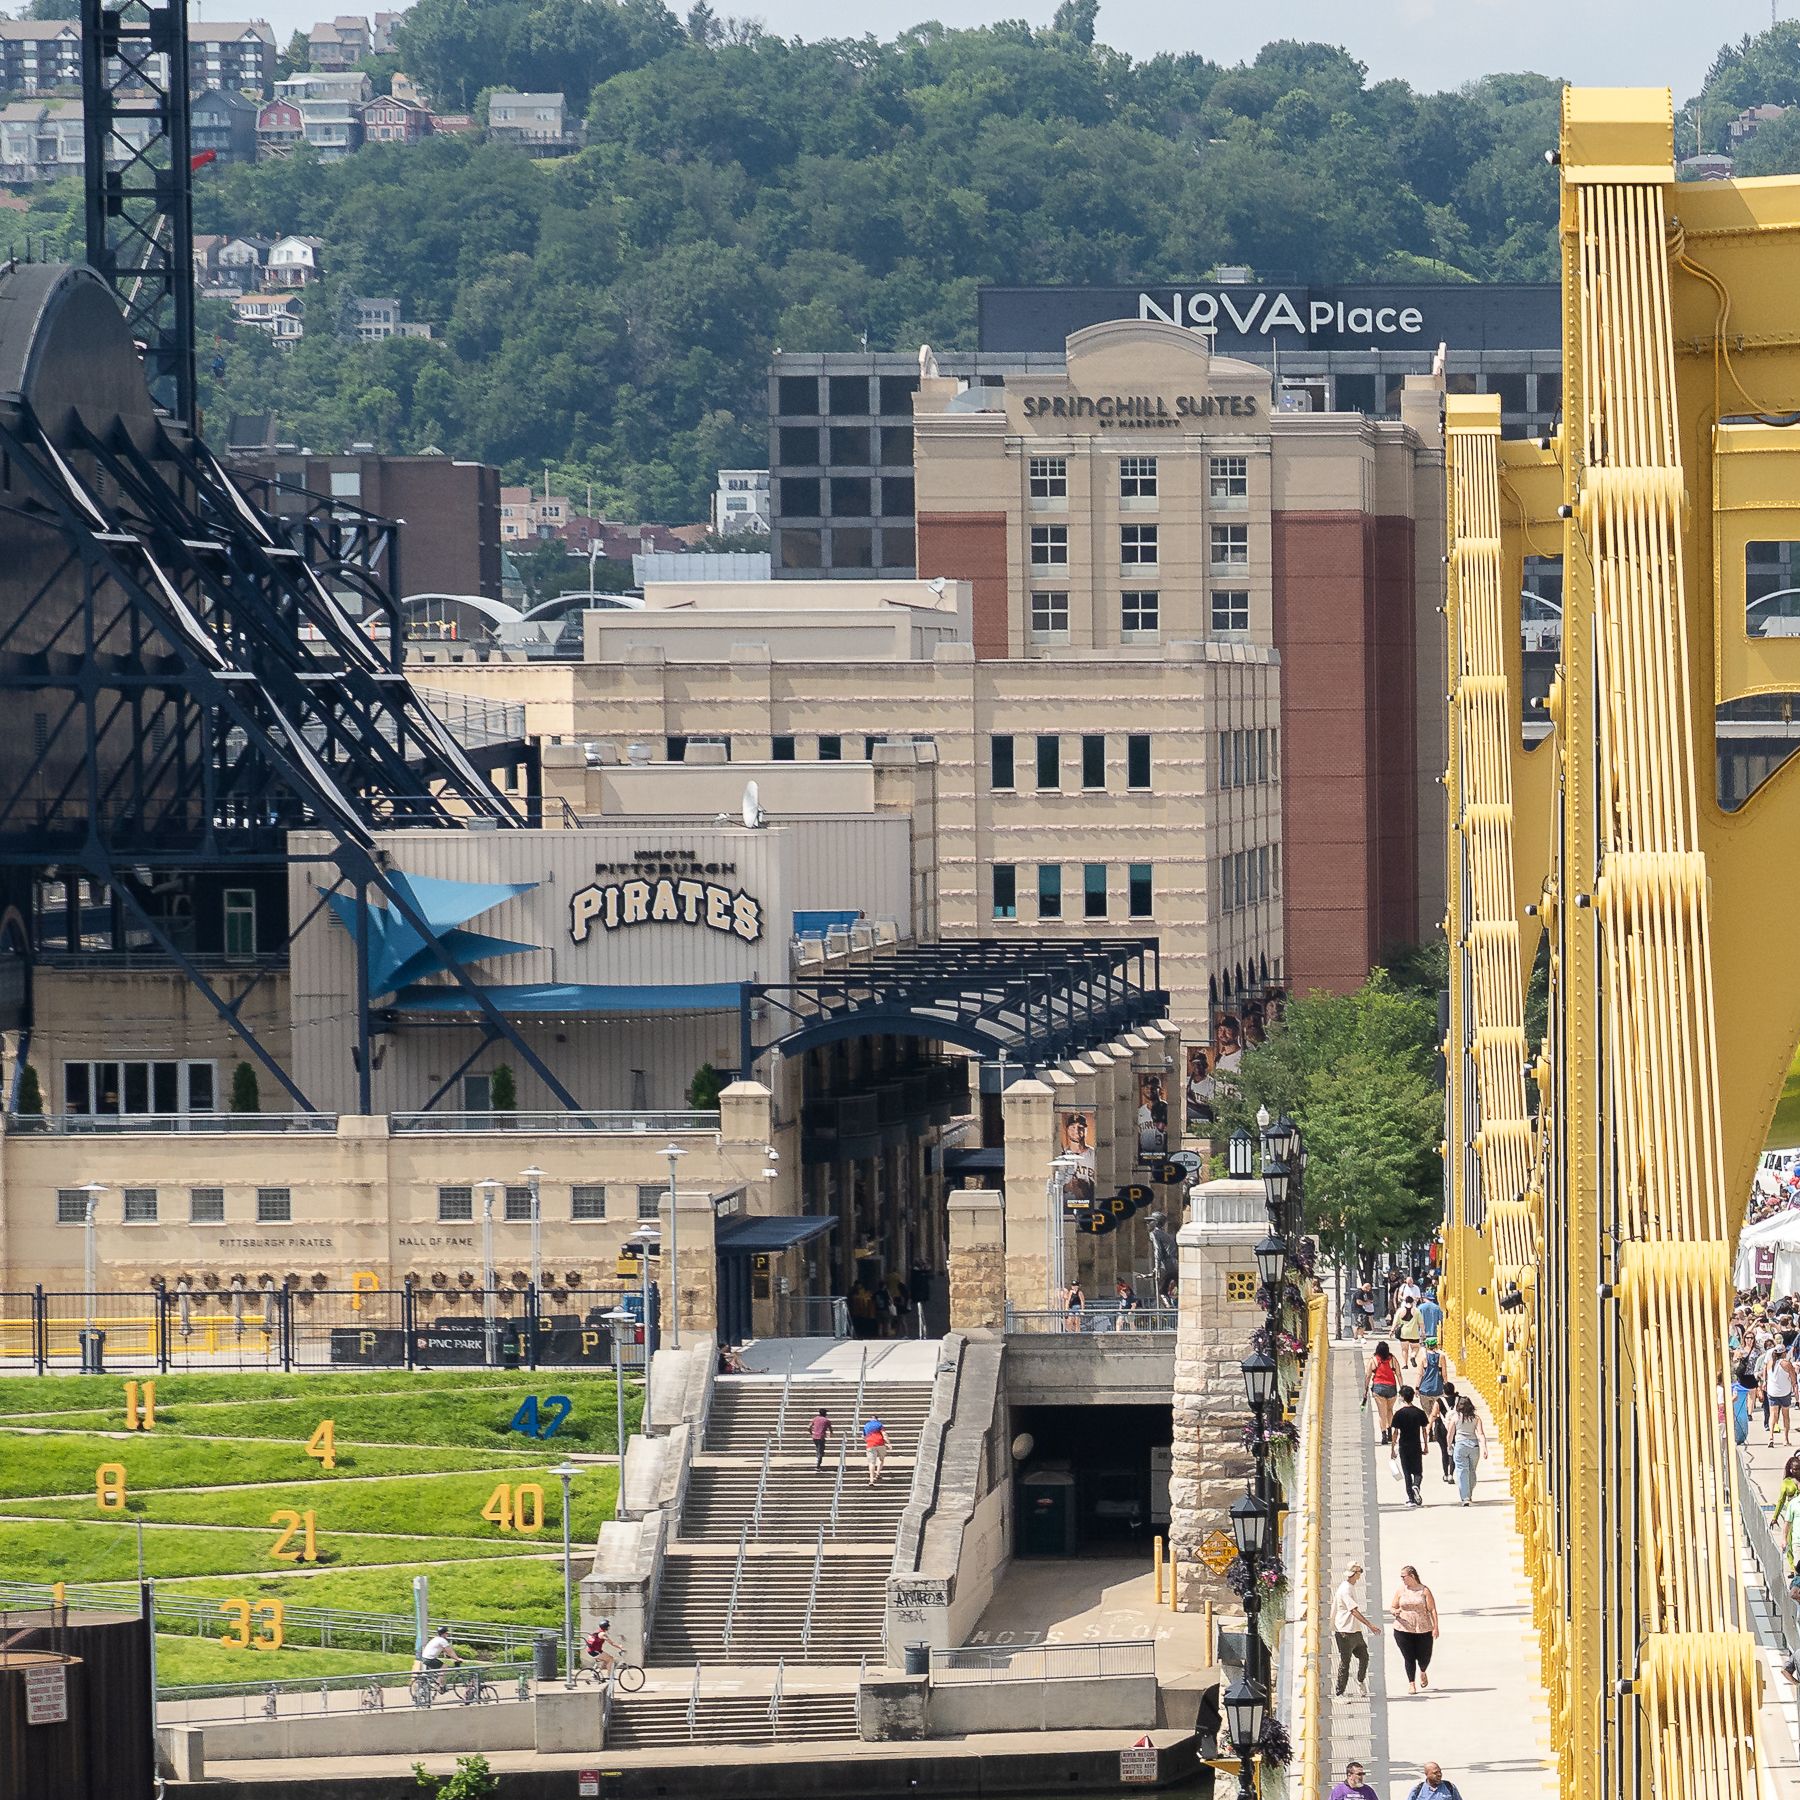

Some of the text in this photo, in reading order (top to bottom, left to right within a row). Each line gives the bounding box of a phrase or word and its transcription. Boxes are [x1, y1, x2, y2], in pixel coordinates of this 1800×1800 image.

[1310, 301, 1423, 333] Place
[1022, 395, 1257, 418] SPRINGHILL SUITES
[1099, 419, 1180, 428] BY MARRIOTT
[634, 850, 697, 860] HOME OF THE
[595, 862, 738, 876] PITTSBURGH
[569, 876, 764, 946] PIRATES
[1163, 1165, 1176, 1182] P
[1130, 1188, 1142, 1201] P
[1111, 1200, 1124, 1215] P
[1091, 1213, 1105, 1231] P
[219, 1236, 473, 1248] PITTSBURGH PIRATES HALL OF FAME
[757, 1256, 766, 1268] P
[351, 1270, 379, 1311] P
[359, 1331, 377, 1355] P
[418, 1338, 483, 1351] PNC PARK
[581, 1331, 599, 1355] P
[123, 1380, 155, 1430] 11
[509, 1394, 573, 1440] 42
[304, 1419, 336, 1469] 4
[96, 1462, 126, 1512] 8
[481, 1482, 545, 1533] 40
[268, 1509, 318, 1561] 21
[219, 1598, 285, 1651] 33
